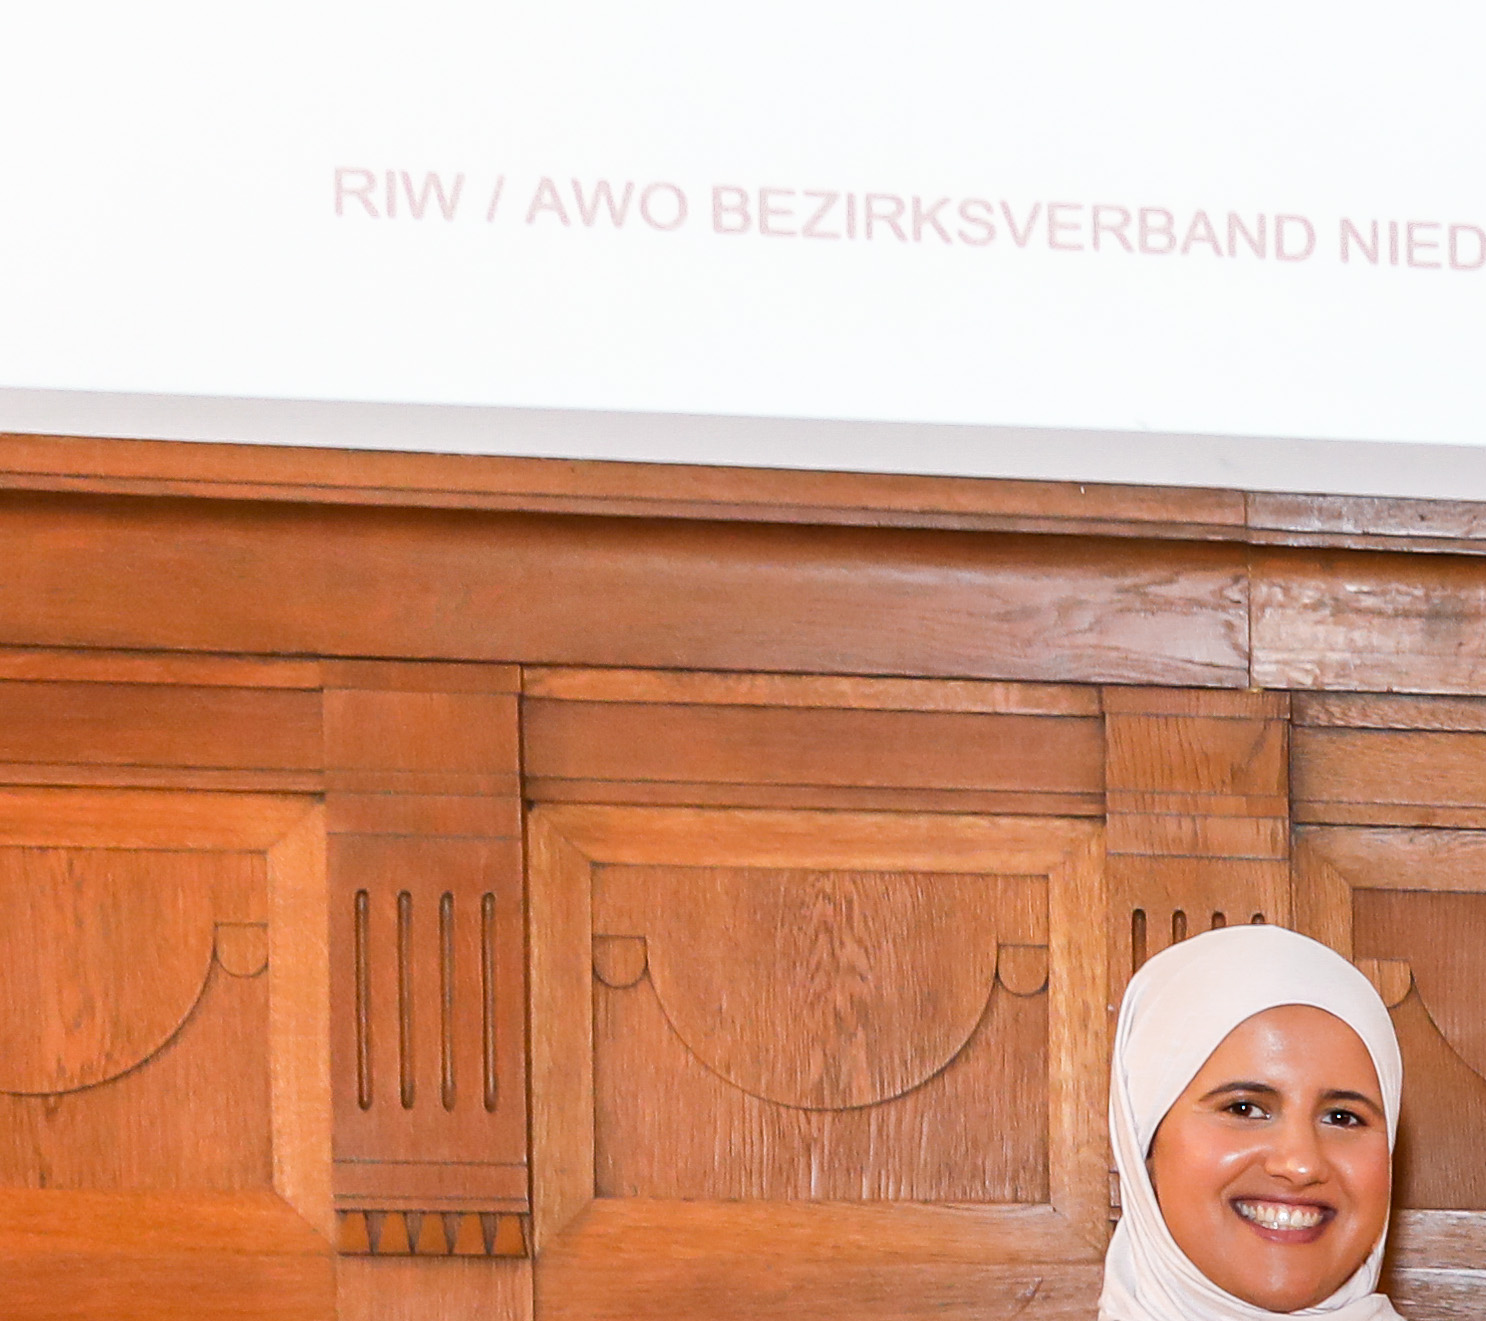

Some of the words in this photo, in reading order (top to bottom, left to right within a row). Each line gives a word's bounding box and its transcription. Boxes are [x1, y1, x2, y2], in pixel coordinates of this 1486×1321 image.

[332, 166, 466, 223] RIW
[524, 175, 689, 233] AWO
[710, 184, 1318, 264] BEZIRKSVERBAND
